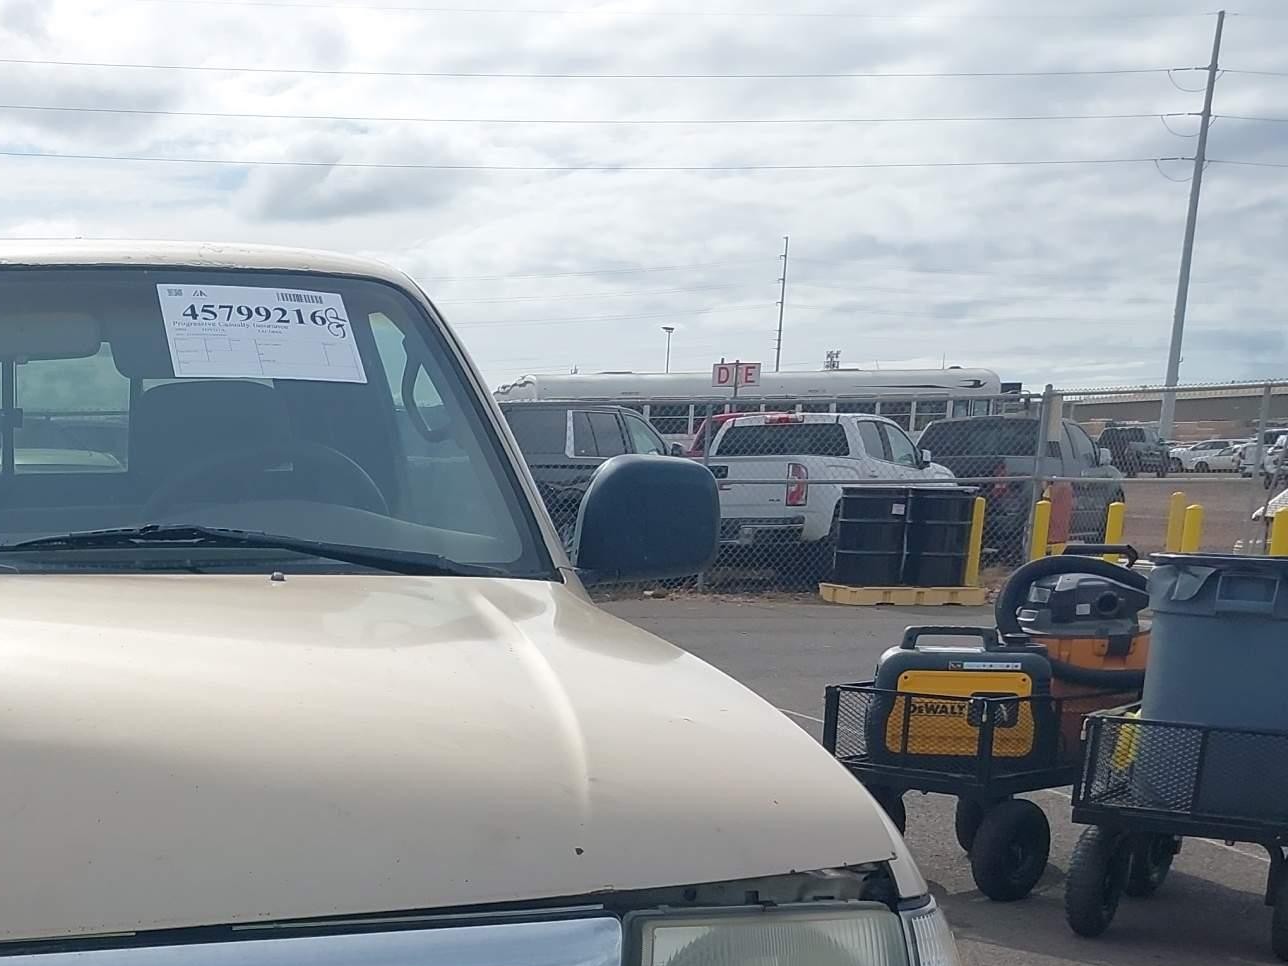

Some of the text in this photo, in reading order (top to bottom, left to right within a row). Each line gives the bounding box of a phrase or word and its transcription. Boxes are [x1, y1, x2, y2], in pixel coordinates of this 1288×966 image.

[182, 303, 326, 326] 45799216
[718, 366, 729, 384] D
[744, 366, 756, 383] E
